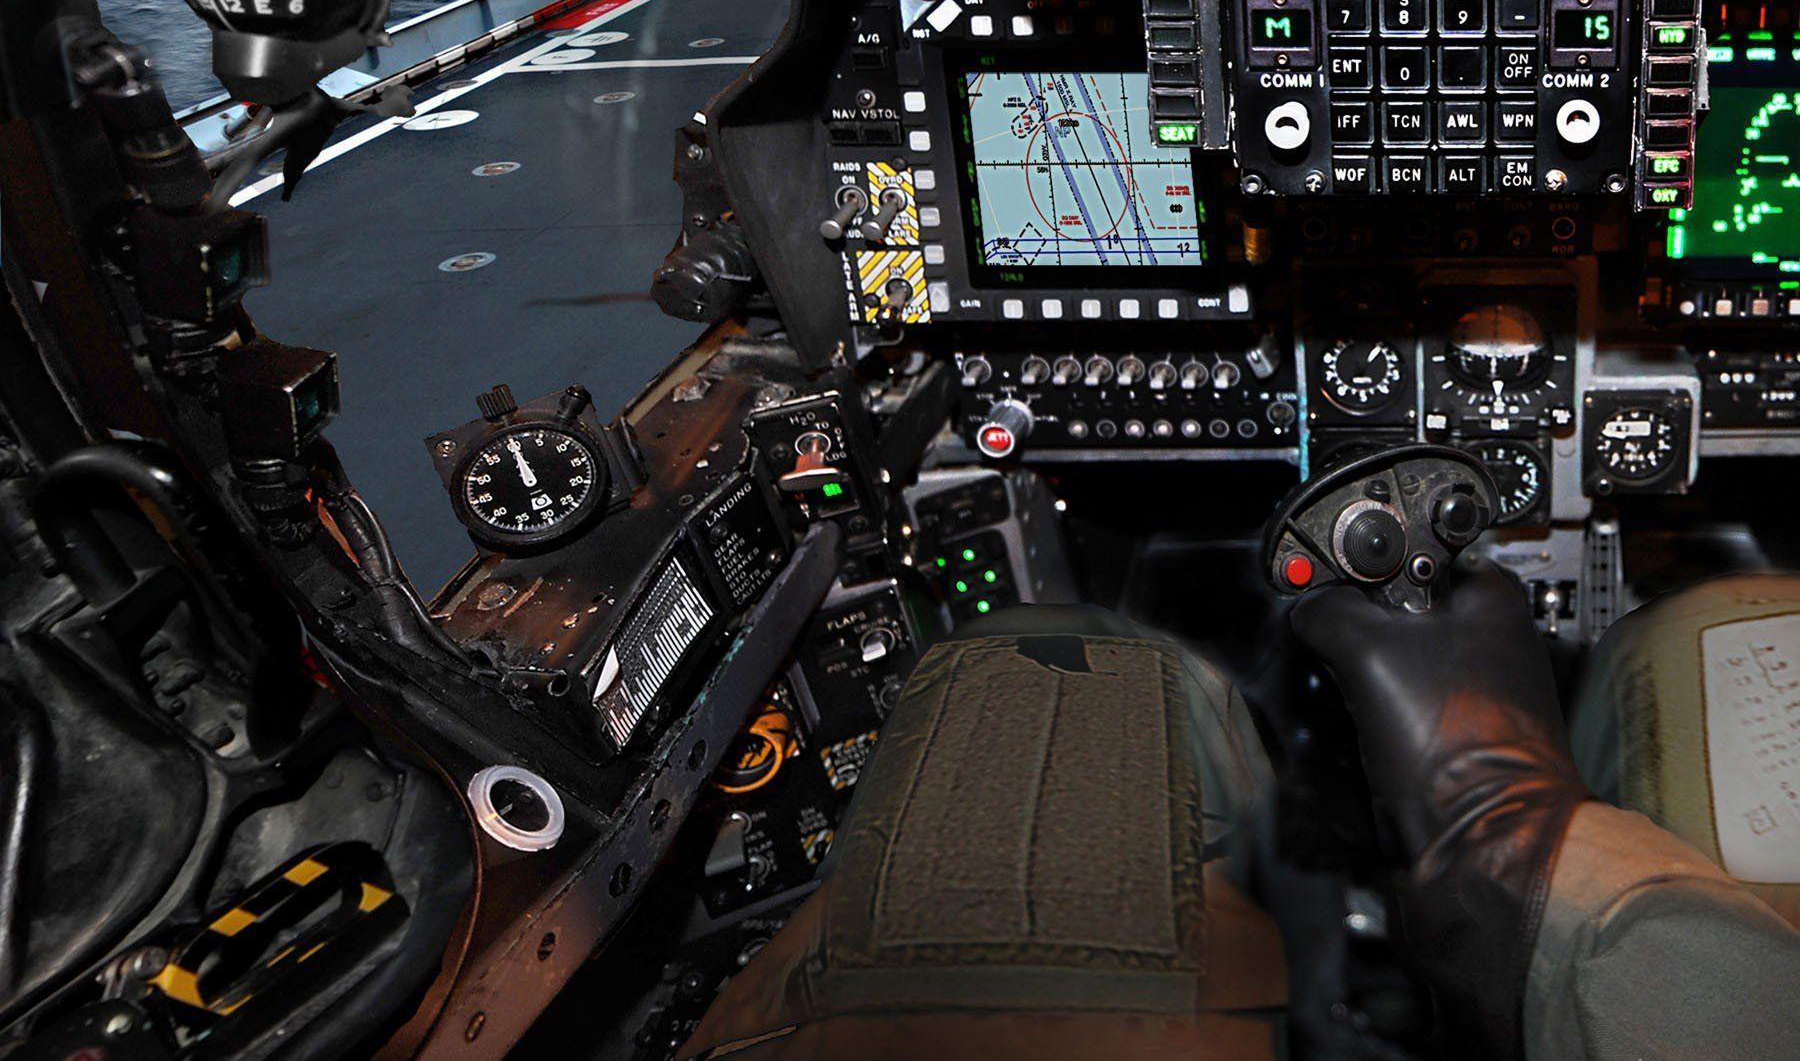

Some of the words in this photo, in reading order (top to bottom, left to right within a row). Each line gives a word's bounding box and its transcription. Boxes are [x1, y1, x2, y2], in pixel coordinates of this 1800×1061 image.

[1341, 10, 1350, 24] 7
[1399, 10, 1409, 25] 8
[1458, 10, 1468, 25] 9
[1265, 17, 1292, 38] M
[858, 34, 880, 44] A/G
[1332, 59, 1362, 73] ENT
[1508, 53, 1529, 65] ON
[1400, 67, 1410, 81] 0
[1504, 66, 1533, 79] OFF
[1260, 73, 1312, 88] COMM
[1542, 73, 1593, 88] COMM
[1599, 74, 1610, 88] 2
[832, 109, 856, 119] NAV
[861, 109, 900, 120] VSTOL
[1337, 115, 1361, 128] IFF
[1391, 114, 1421, 128] TCN
[1446, 114, 1478, 128] AWL
[1502, 114, 1534, 128] WPN
[1159, 126, 1196, 142] SEAT
[1334, 168, 1366, 182] WOF
[1392, 168, 1422, 182] BCN
[1449, 168, 1476, 182] ALT
[1506, 162, 1528, 174] EM
[842, 176, 856, 185] ON
[1502, 175, 1532, 187] CON
[1652, 189, 1678, 203] OXY
[789, 412, 816, 426] H2O
[814, 421, 830, 430] TO
[535, 439, 544, 447] 5
[556, 443, 567, 453] 10
[486, 454, 501, 466] 55
[570, 457, 582, 468] 15
[476, 474, 491, 485] 50
[569, 475, 584, 487] 20
[478, 493, 493, 504] 45
[560, 494, 575, 506] 25
[705, 482, 752, 528] LANDING
[493, 506, 507, 517] 40
[515, 512, 530, 524] 35
[540, 509, 555, 520] 30
[714, 532, 738, 558] GEAR
[718, 537, 745, 567] FLAPS
[721, 552, 745, 575] FUEL
[725, 547, 760, 583] BRAKES
[827, 611, 867, 631] FLAPS
